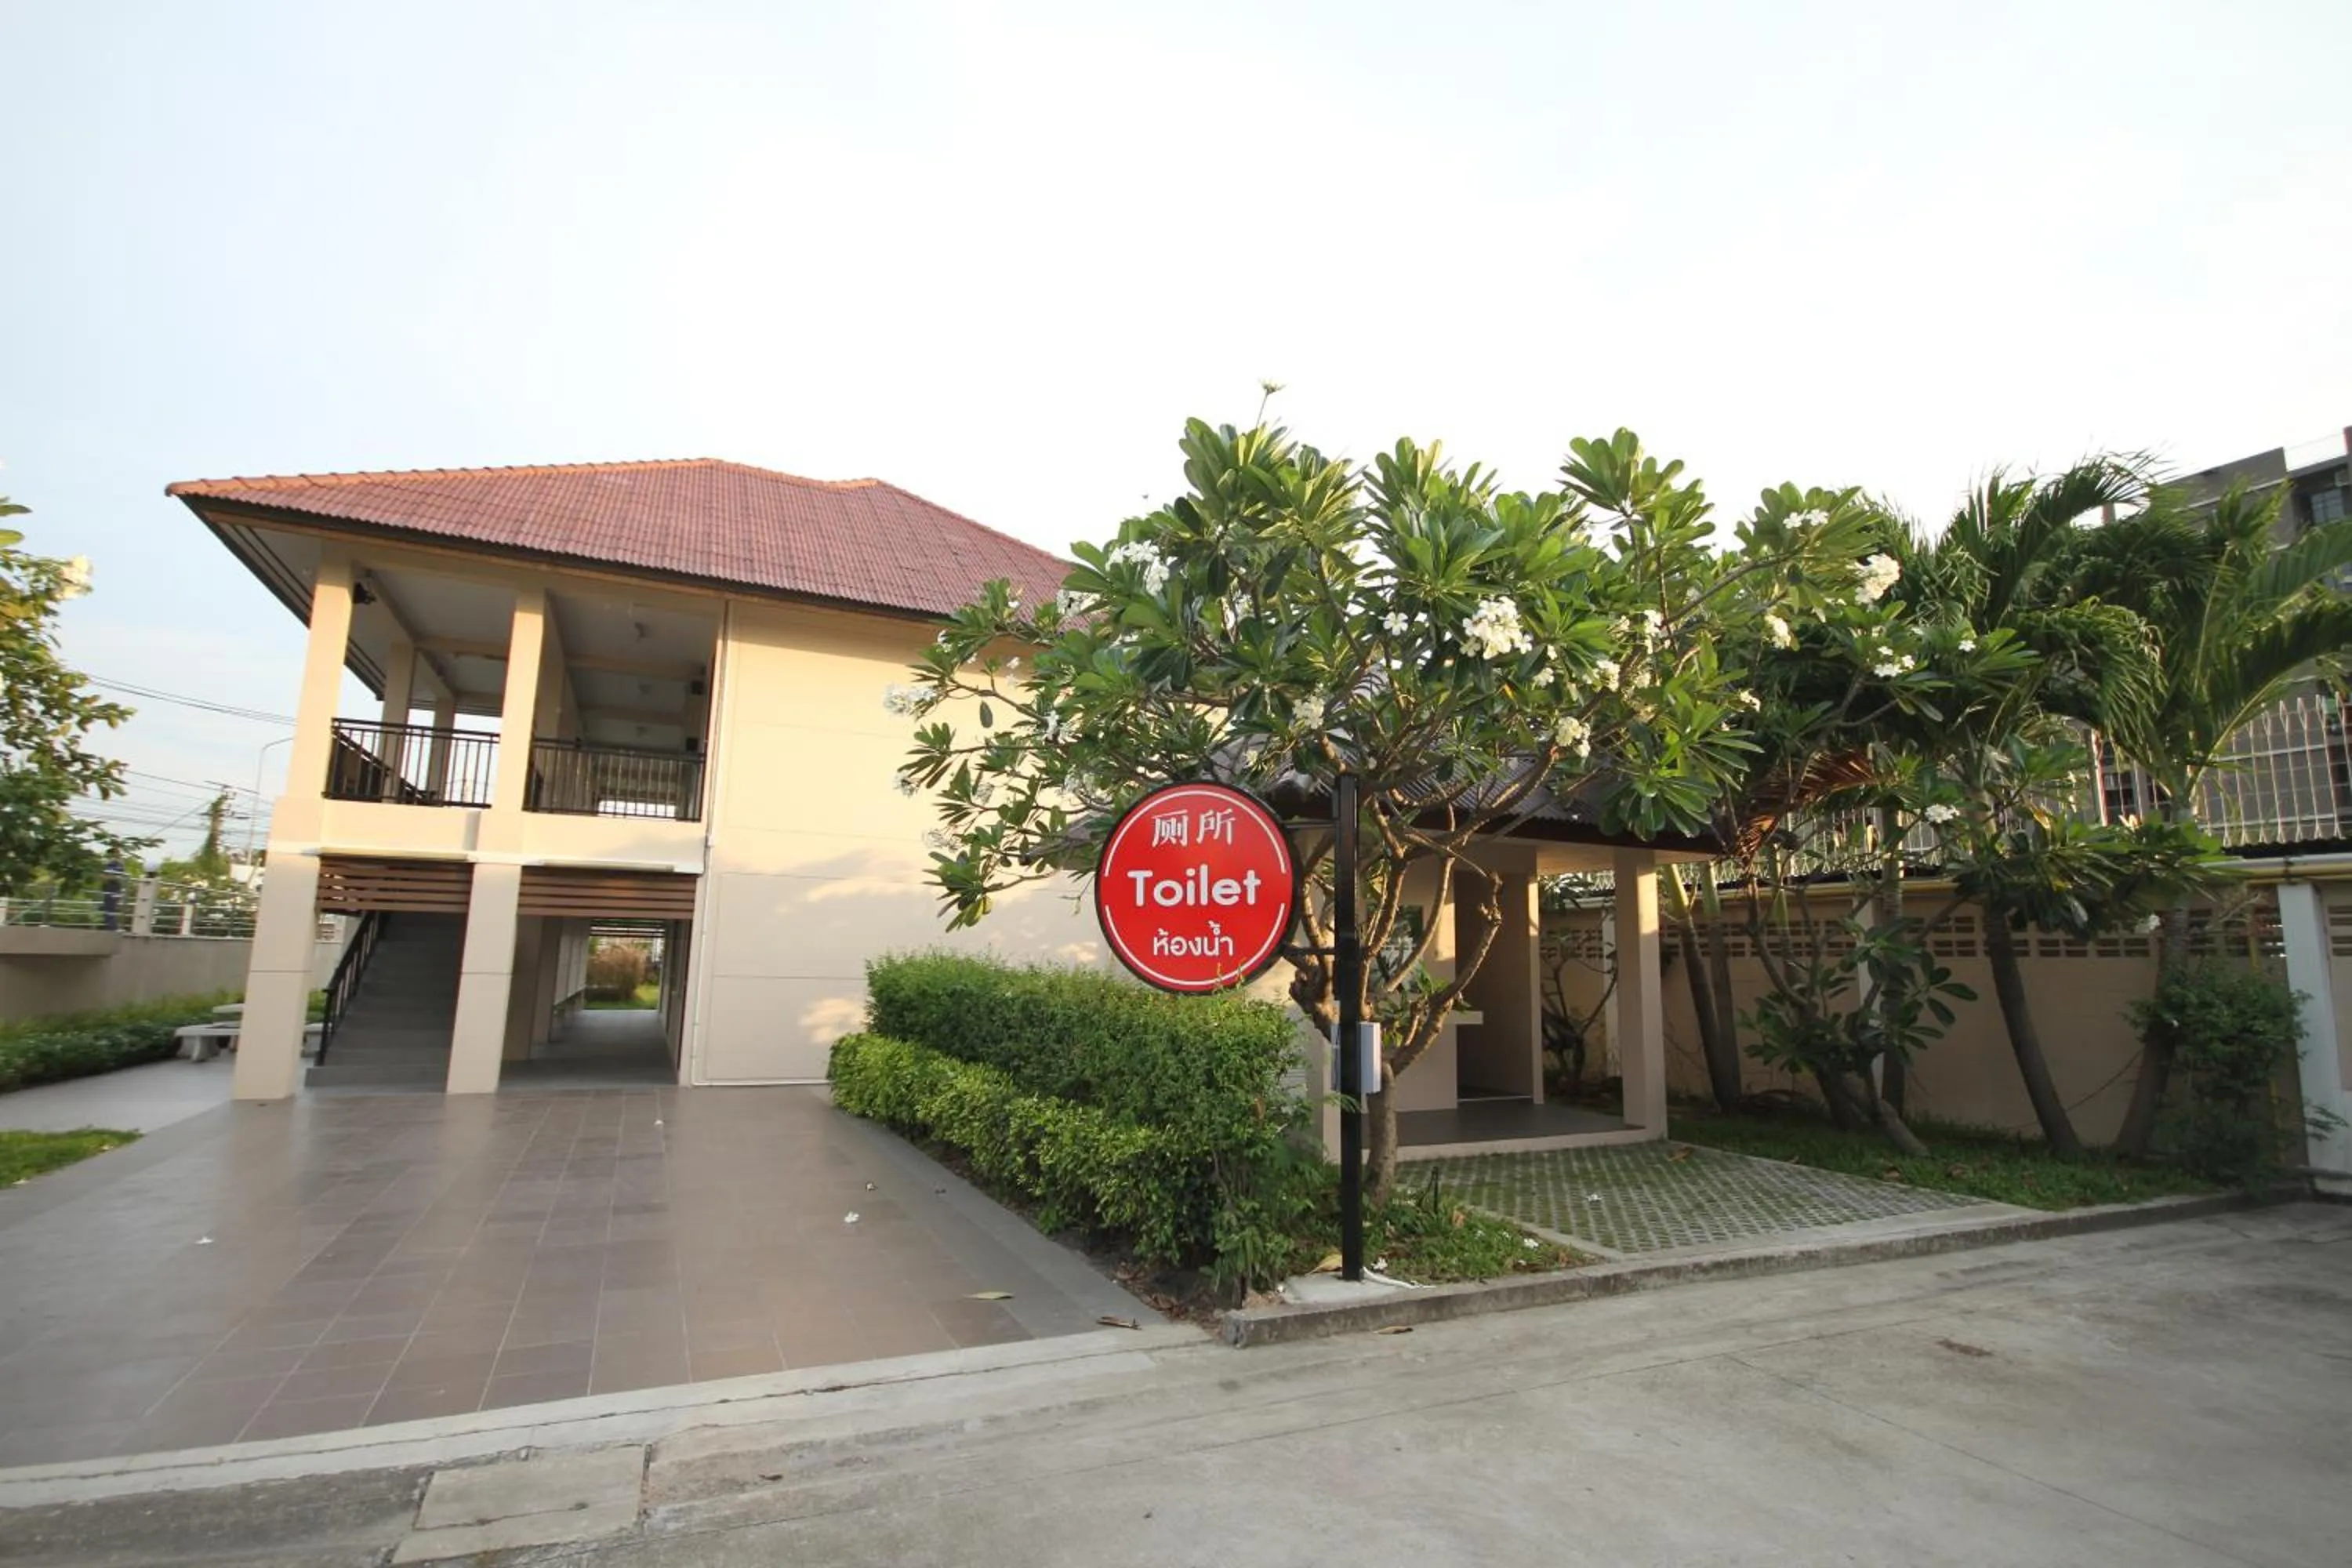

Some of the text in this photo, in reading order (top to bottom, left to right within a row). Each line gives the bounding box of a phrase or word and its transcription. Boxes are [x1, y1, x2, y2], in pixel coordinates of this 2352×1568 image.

[1152, 808, 1236, 847] 厕所
[1127, 864, 1261, 906] Toilet
[1153, 920, 1233, 956] ห้องน้ำ
